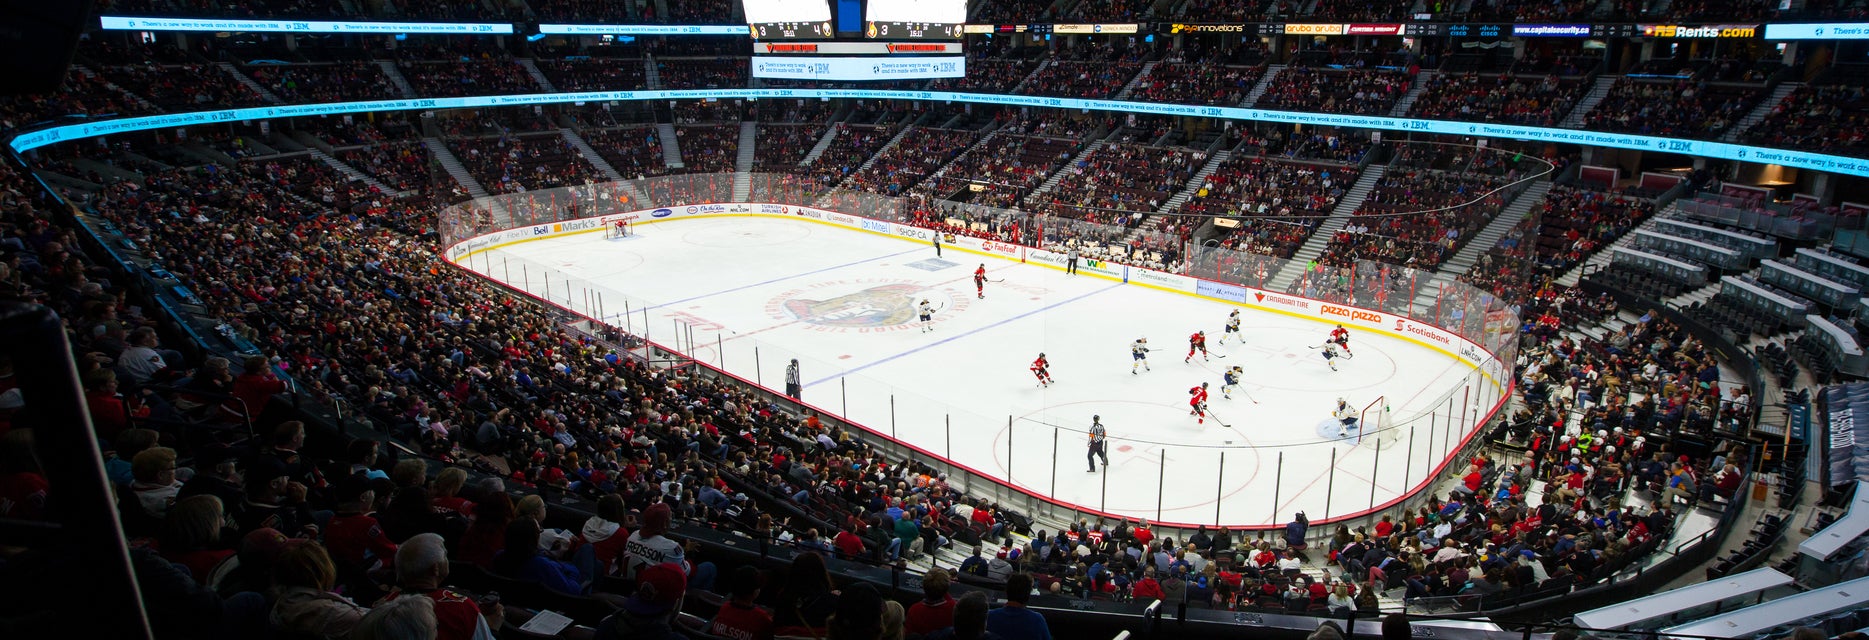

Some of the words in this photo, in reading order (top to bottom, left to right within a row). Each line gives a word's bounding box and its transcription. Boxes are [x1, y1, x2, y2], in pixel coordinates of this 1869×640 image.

[760, 26, 767, 36] 3
[814, 25, 821, 35] 4
[881, 25, 888, 35] 3
[945, 26, 952, 37] 4
[1514, 26, 1590, 35] www.capitalsecurity.ca
[1833, 27, 1862, 35] There's
[815, 63, 830, 74] IBM
[940, 62, 956, 72] IBM
[219, 112, 236, 120] IBM
[1208, 108, 1223, 116] IBM
[1410, 121, 1430, 130] IBM
[1668, 140, 1692, 152] IBM
[1755, 151, 1783, 161] There's
[1810, 159, 1826, 167] way
[1837, 162, 1855, 170] work
[534, 225, 549, 235] Bell
[562, 220, 596, 232] Mark's
[871, 222, 889, 232] Mitel
[1087, 259, 1107, 270] WM
[1090, 267, 1120, 276] MANAGEMENT
[1141, 273, 1167, 282] metroland
[1266, 295, 1295, 307] CANADIAN
[1296, 300, 1309, 309] TIRE
[1321, 305, 1350, 318] pizza
[1351, 310, 1382, 323] pizza
[1407, 324, 1450, 345] Scotiabank
[1461, 347, 1482, 364] LNH.COM
